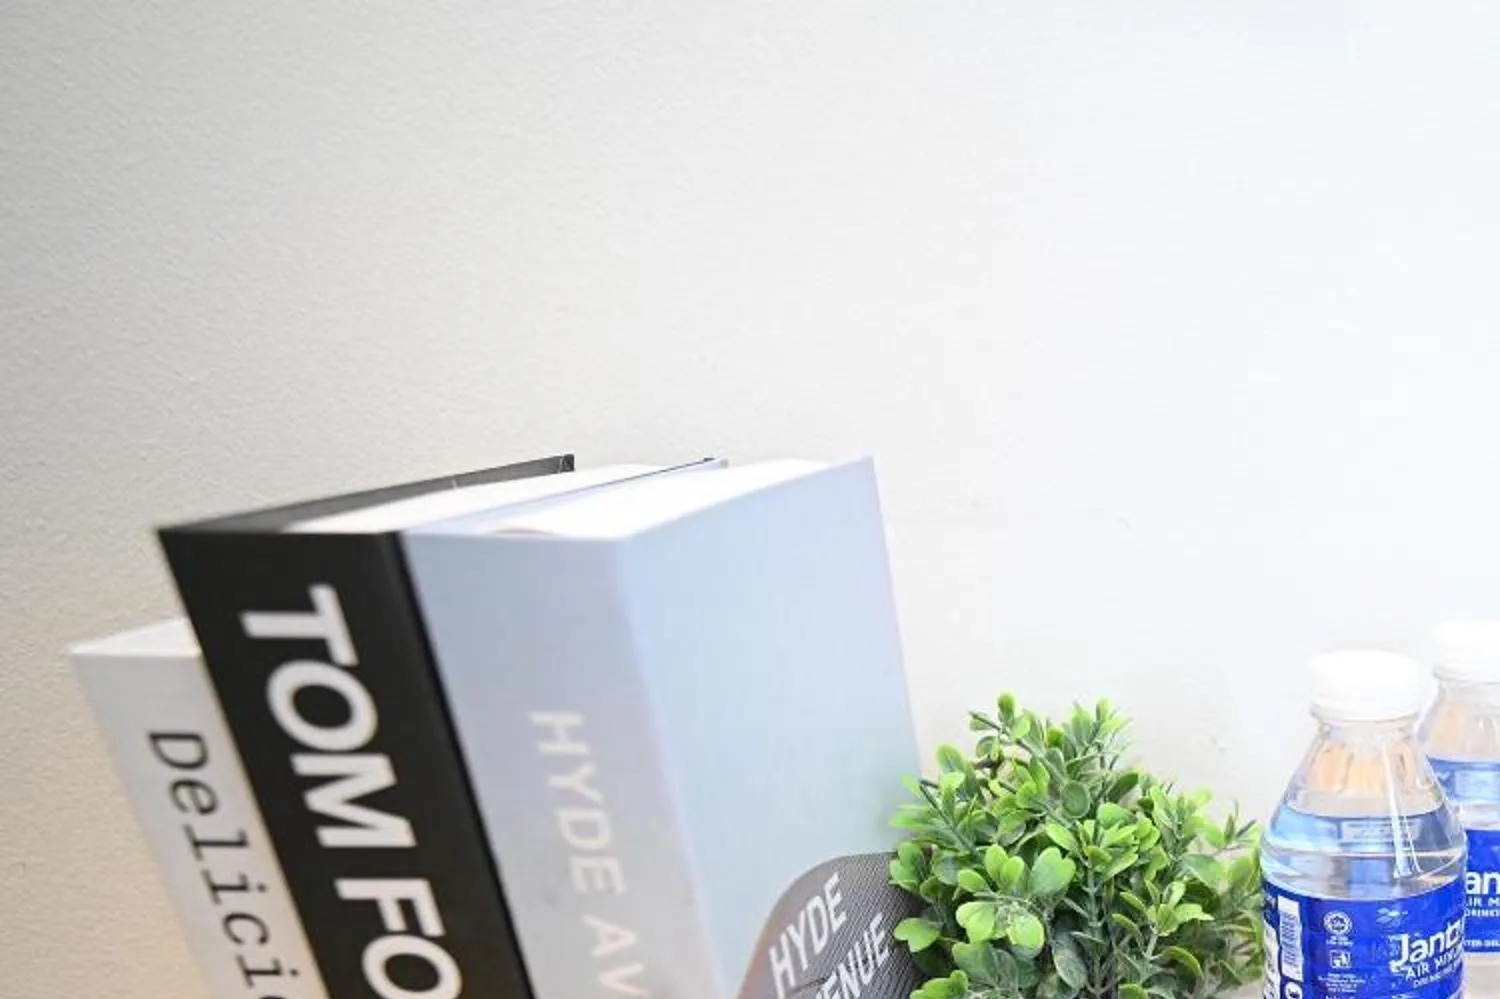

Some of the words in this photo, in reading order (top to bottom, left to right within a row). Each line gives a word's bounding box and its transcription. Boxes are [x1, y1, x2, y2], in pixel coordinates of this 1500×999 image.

[239, 583, 417, 848] TOM
[530, 711, 627, 896] HYDE
[1389, 918, 1462, 973] Jantz
[1466, 897, 1482, 907] IR
